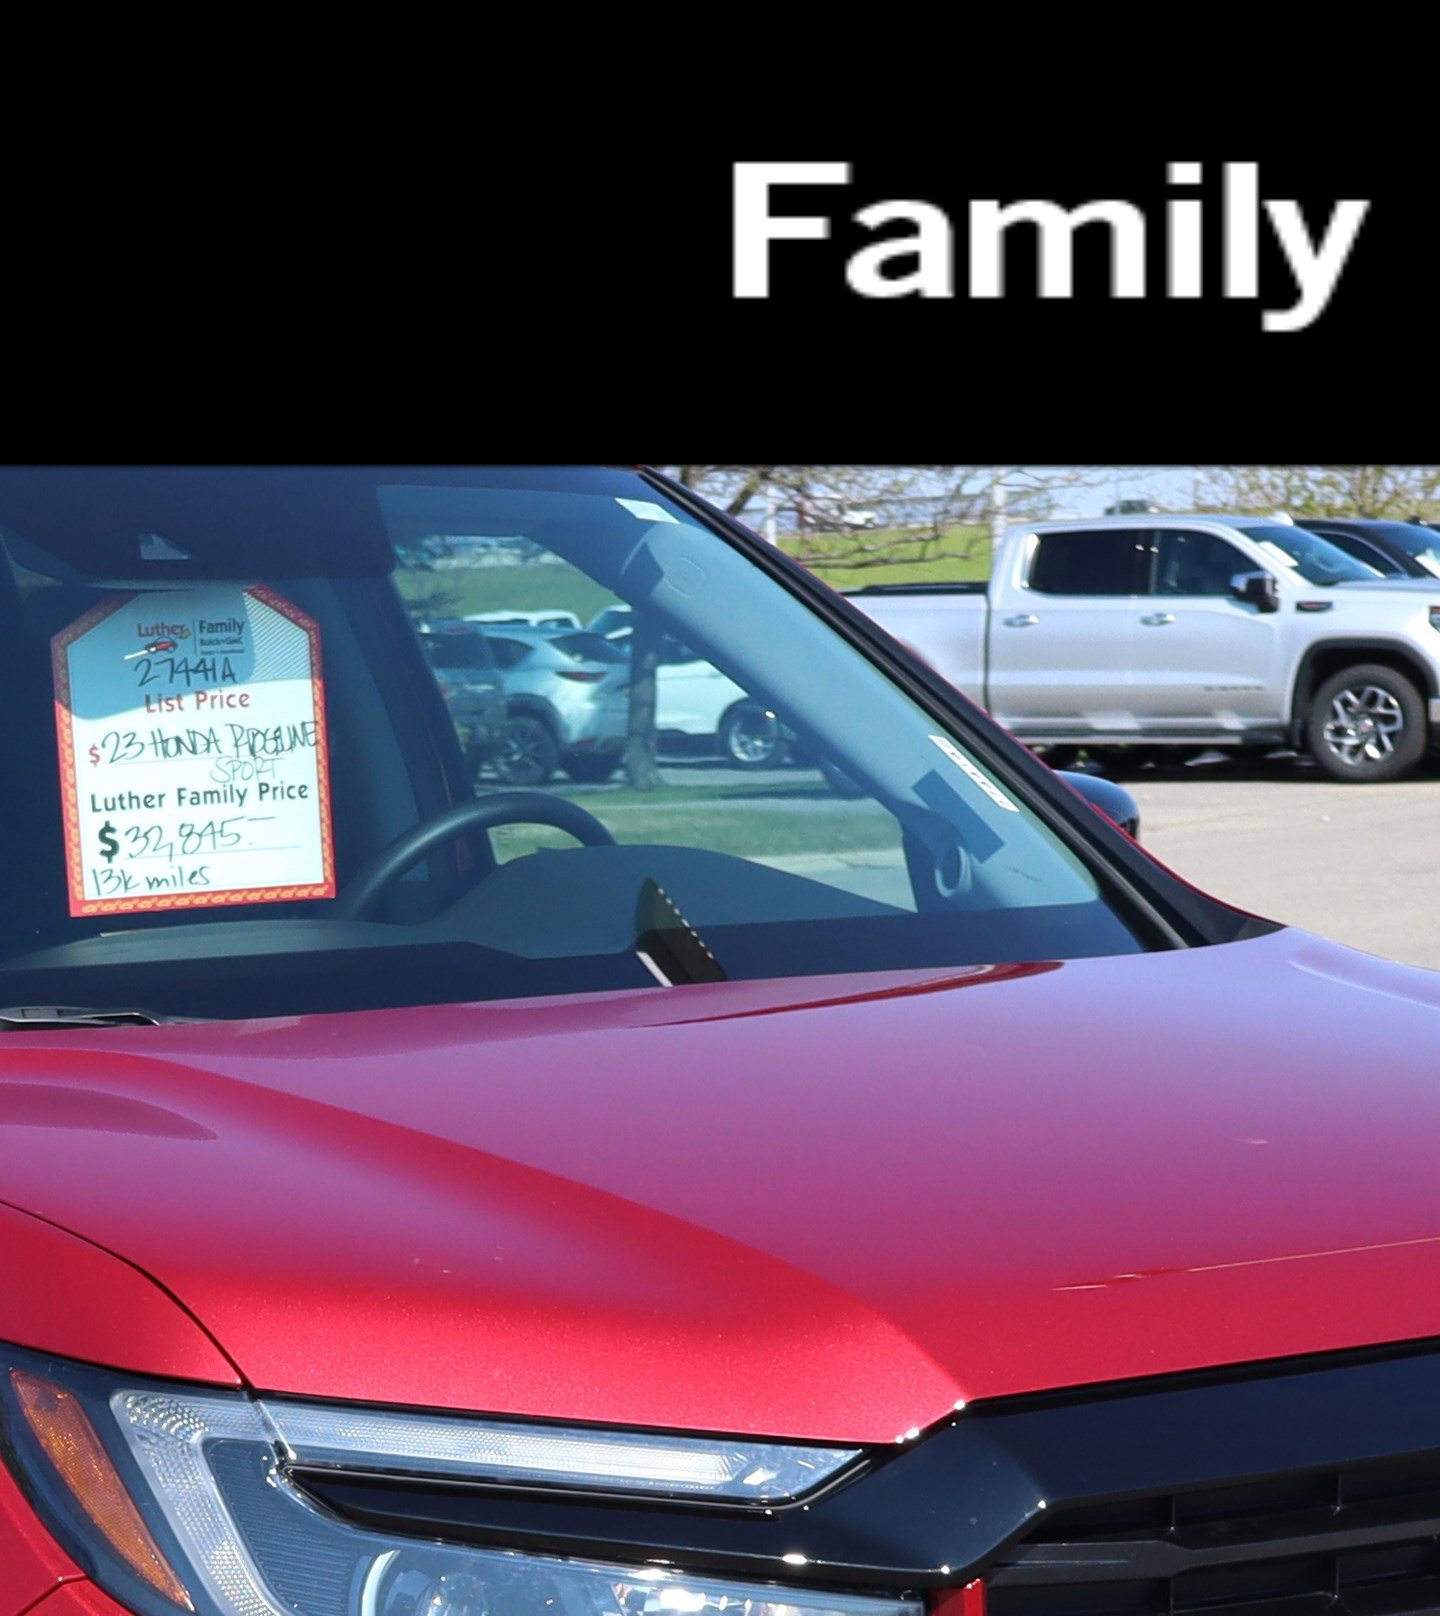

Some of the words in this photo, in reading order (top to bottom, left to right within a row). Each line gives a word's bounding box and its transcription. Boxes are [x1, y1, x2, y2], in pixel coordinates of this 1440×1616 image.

[137, 622, 186, 637] Luther
[199, 618, 244, 636] Family
[144, 693, 184, 713] List
[195, 689, 251, 712] Price
[91, 789, 165, 813] Luther
[177, 784, 248, 808] Family
[258, 780, 310, 801] Price
